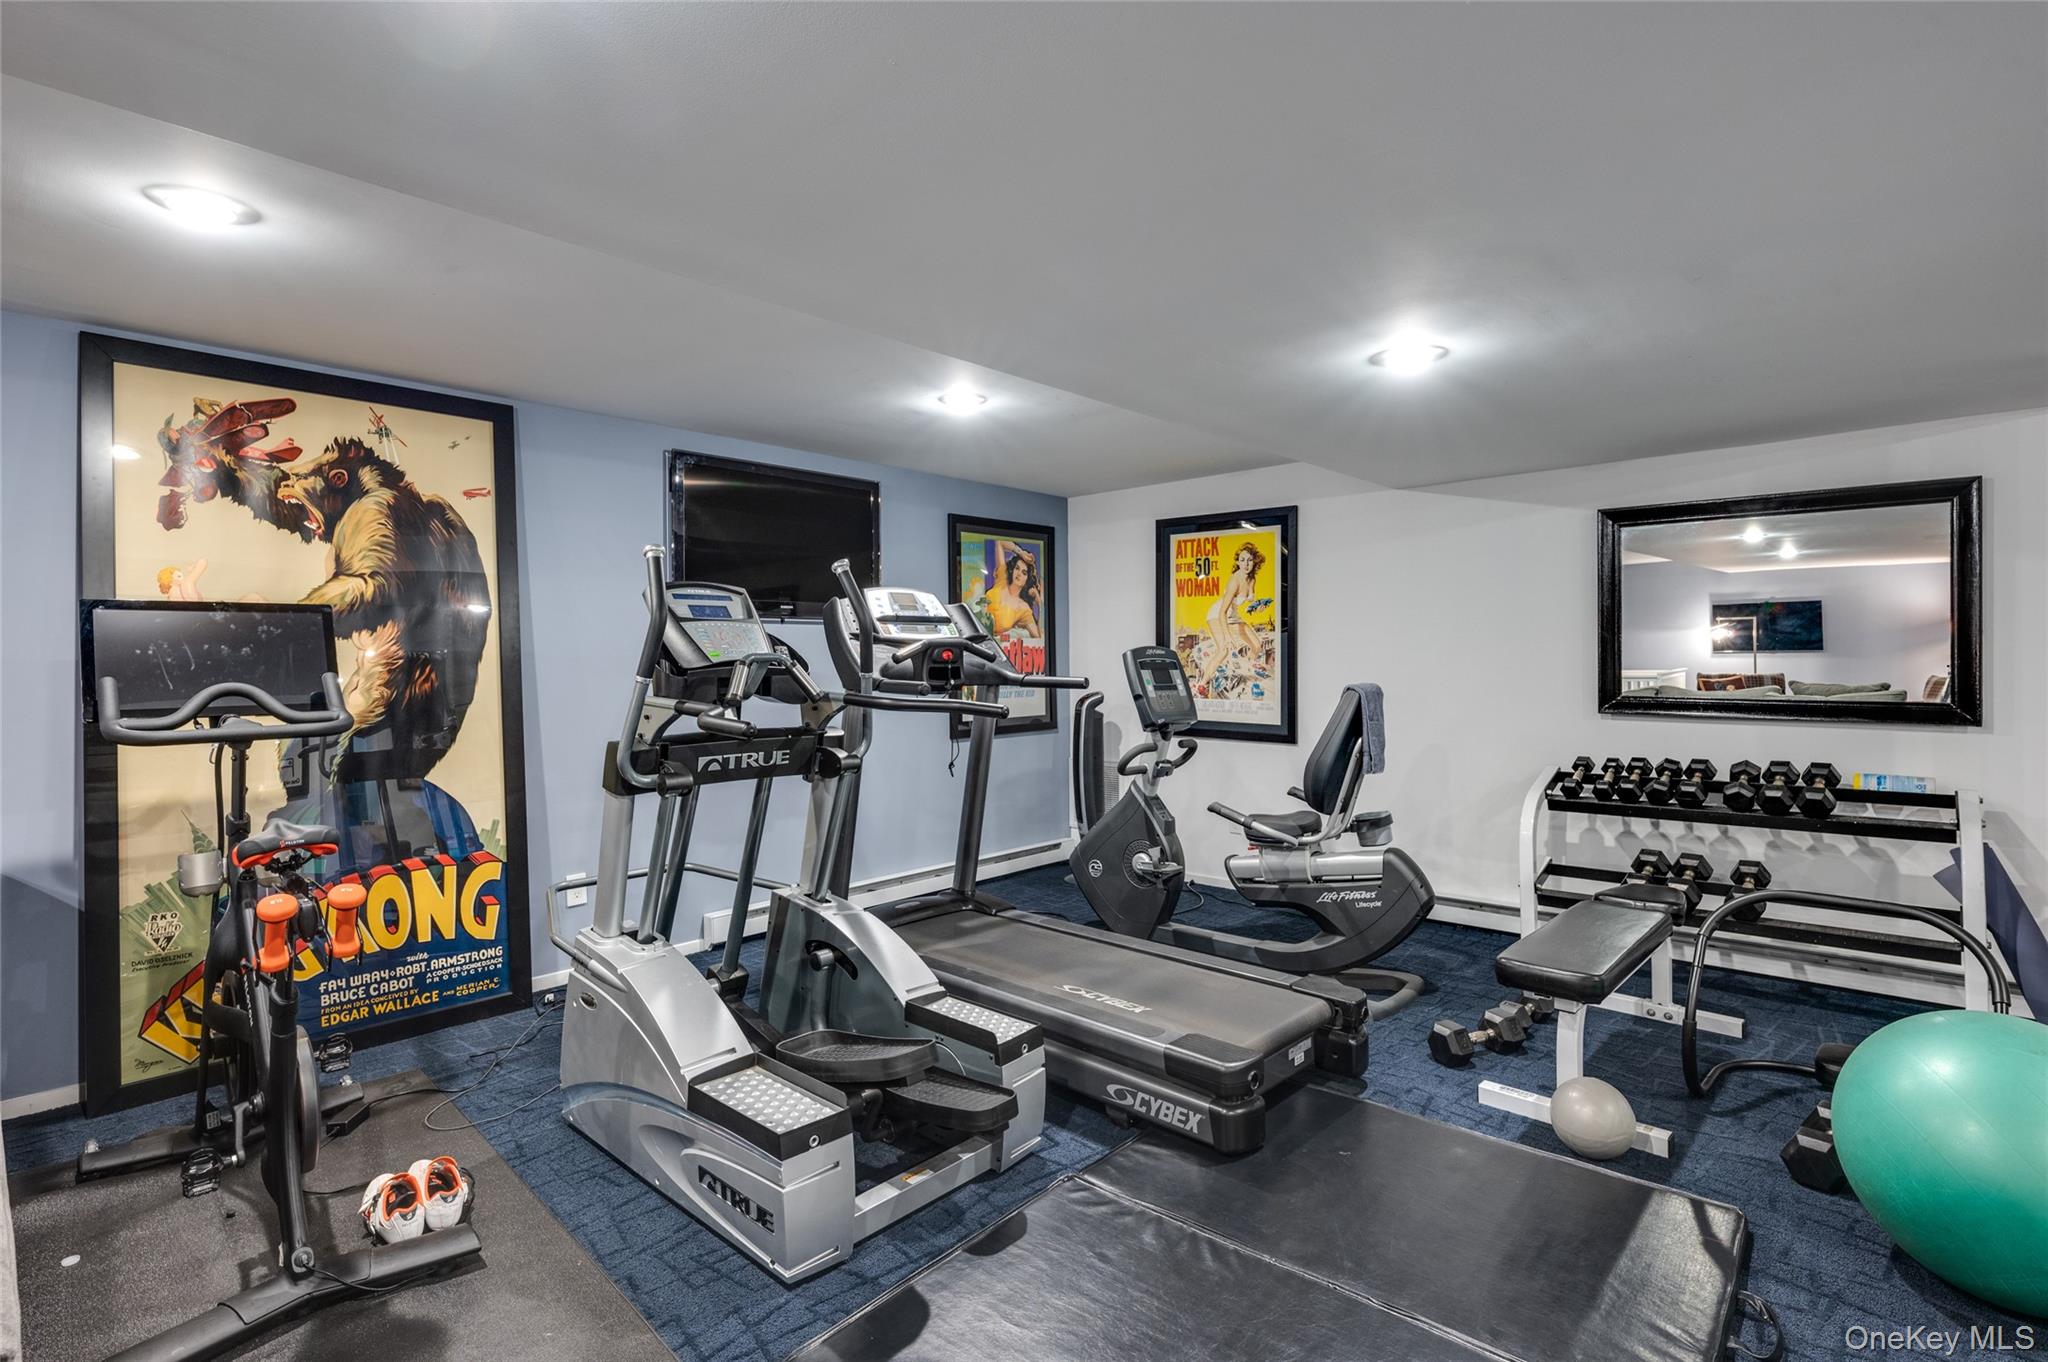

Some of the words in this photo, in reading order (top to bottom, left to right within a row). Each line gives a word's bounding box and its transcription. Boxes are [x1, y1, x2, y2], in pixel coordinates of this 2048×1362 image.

[1176, 537, 1219, 560] ATTACK
[1183, 562, 1194, 572] THE
[1195, 557, 1210, 577] 50
[1176, 577, 1220, 598] WOMAN
[723, 750, 790, 767] TRUE
[151, 912, 178, 922] RKO
[131, 959, 154, 968] DAVID
[319, 979, 347, 994] FAY
[350, 968, 390, 987] WRAY
[430, 946, 503, 971] ARMSTRONG
[426, 963, 502, 984] PRODUCTION
[320, 987, 366, 1007] BRUCE
[369, 976, 415, 996] CABOT
[456, 984, 501, 997] COOPER
[320, 1007, 369, 1028] EDGAR
[372, 991, 440, 1016] WALLACE
[353, 999, 370, 1007] IDEA
[1086, 991, 1152, 1014] CYBEX
[1133, 1090, 1203, 1134] CYBEX
[715, 1177, 775, 1233] TRUE
